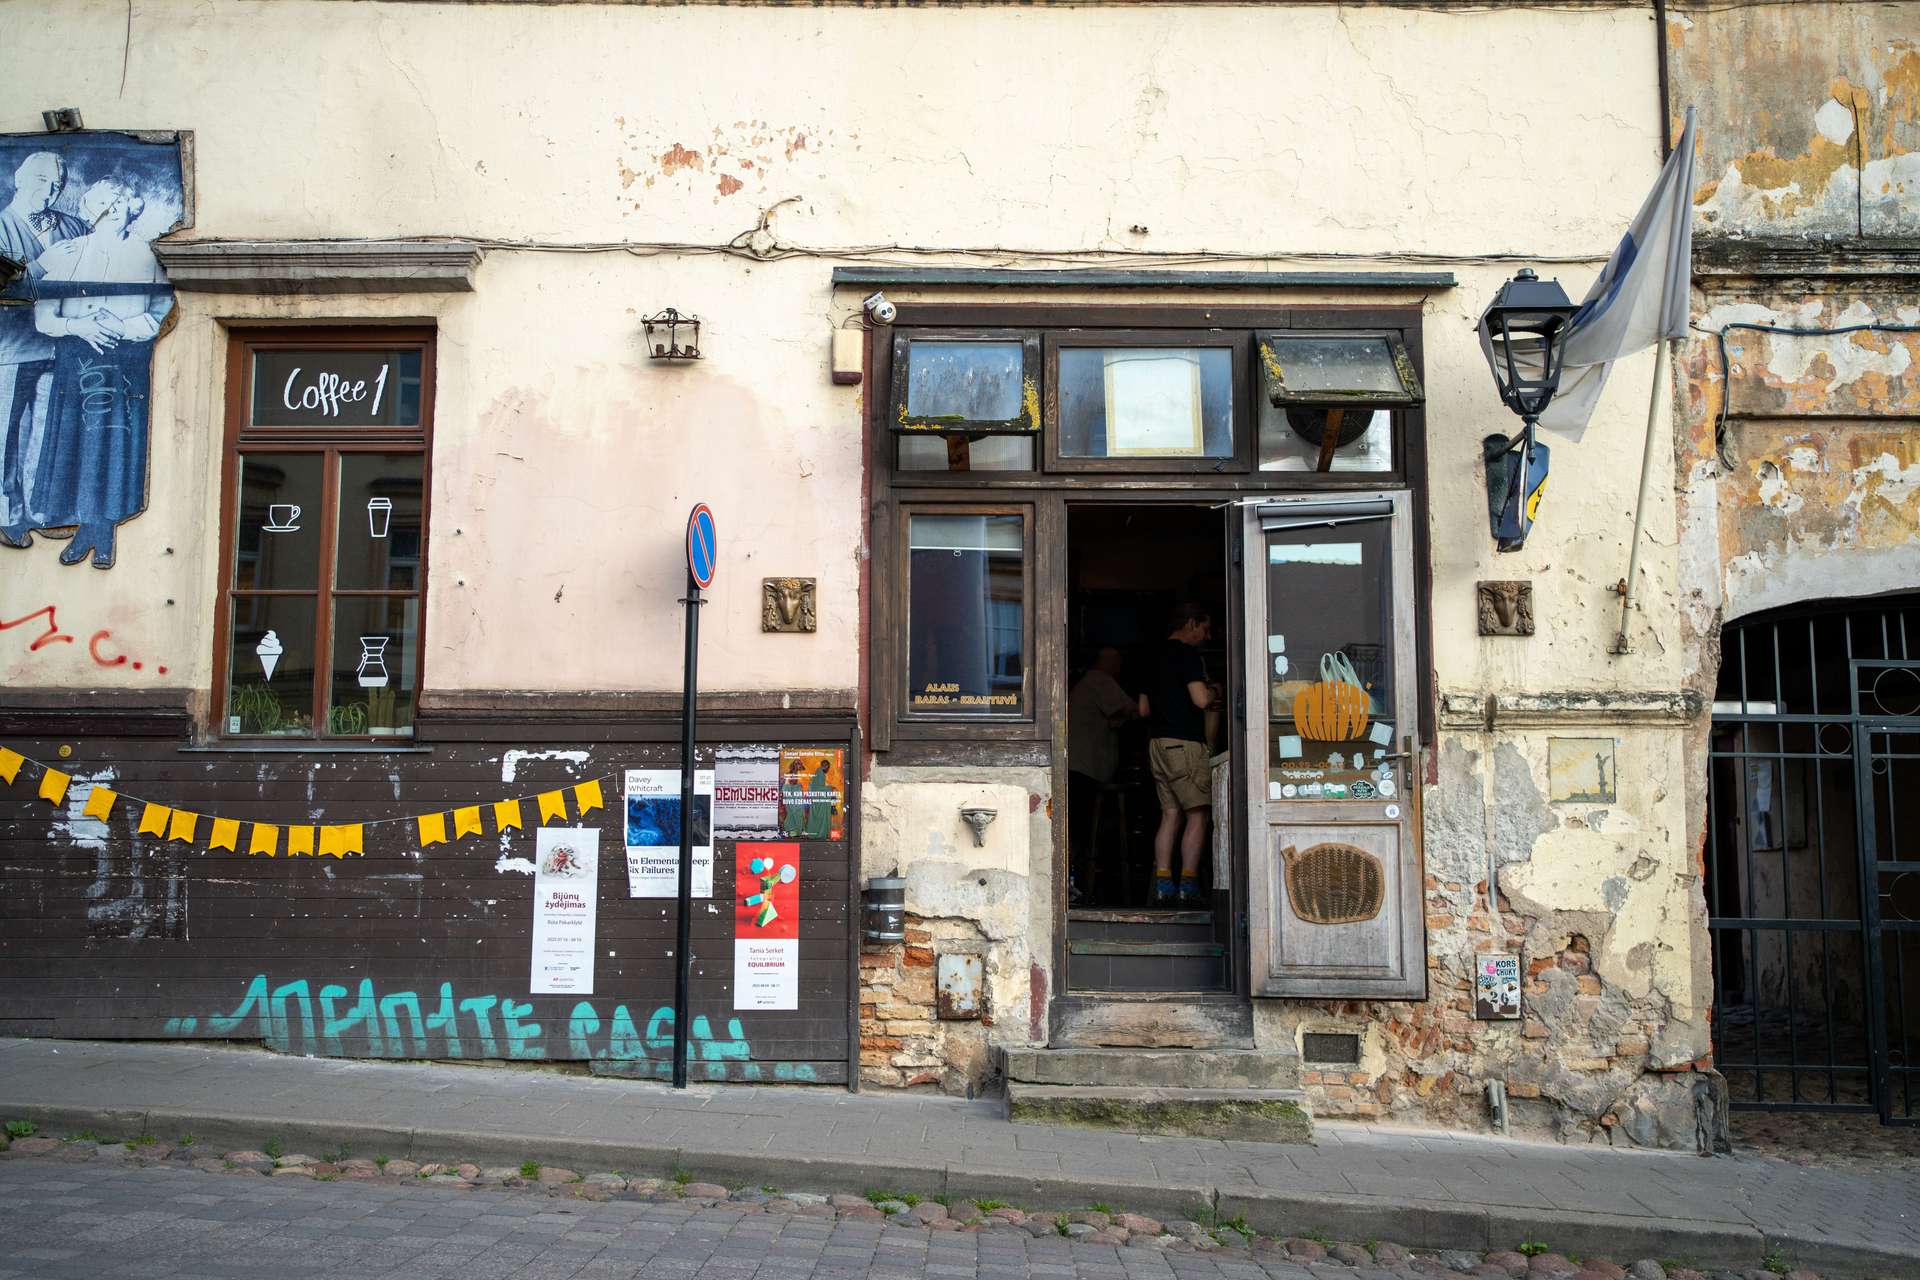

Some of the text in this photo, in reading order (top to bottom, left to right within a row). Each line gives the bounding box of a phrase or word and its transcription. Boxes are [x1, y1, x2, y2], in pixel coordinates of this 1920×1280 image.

[283, 364, 389, 416] Coffee 1
[914, 695, 949, 704] BARAS
[628, 775, 652, 784] Davey
[628, 784, 663, 792] Whitcraft
[640, 857, 680, 865] Elementa
[692, 858, 710, 867] eep:
[641, 866, 675, 874] Failures
